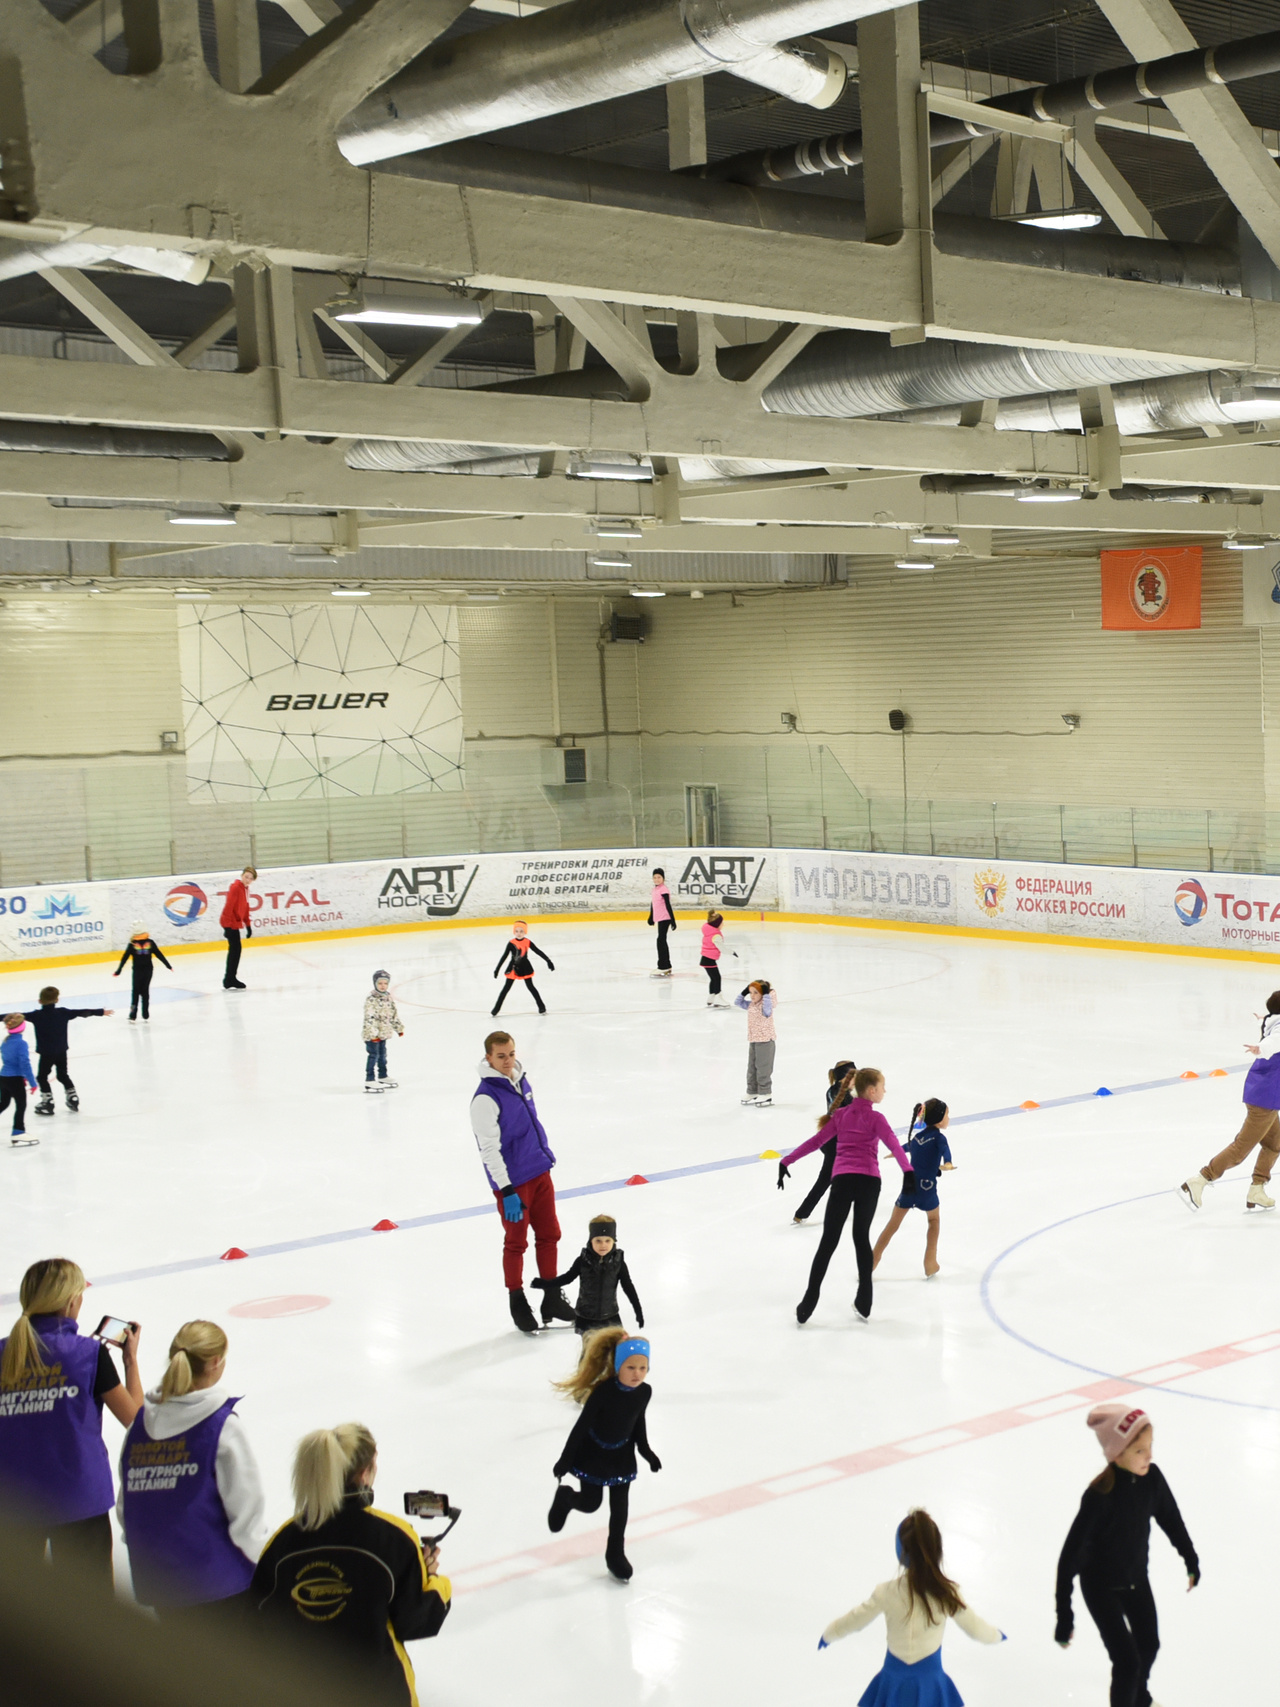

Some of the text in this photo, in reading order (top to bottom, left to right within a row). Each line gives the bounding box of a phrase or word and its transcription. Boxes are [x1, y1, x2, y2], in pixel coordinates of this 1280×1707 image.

[521, 857, 649, 870] ТРЕНИРОВКИ ДЛЯ ДЕТЕЙ
[679, 856, 755, 883] ART
[380, 865, 465, 896] ART
[515, 871, 624, 884] ПРОФЕССИОНАЛОВ
[509, 884, 610, 897] ШКОЛА ВРАТАРЕЙ
[677, 883, 749, 895] HOCKEY
[794, 866, 951, 908] МОРОЗОВО
[1015, 877, 1093, 897] ФЕДЕРАЦИЯ
[378, 893, 458, 909] HOCKEY
[1016, 897, 1126, 919] ХОККЕЯ РОССИИ
[300, 911, 343, 924] МАСЛА
[18, 920, 104, 938] МОРОЗОВО
[1222, 928, 1280, 942] МОТОРНЫЕ
[127, 1462, 199, 1480] ФИГУРНОГО
[127, 1476, 178, 1492] КАТАНИЯ
